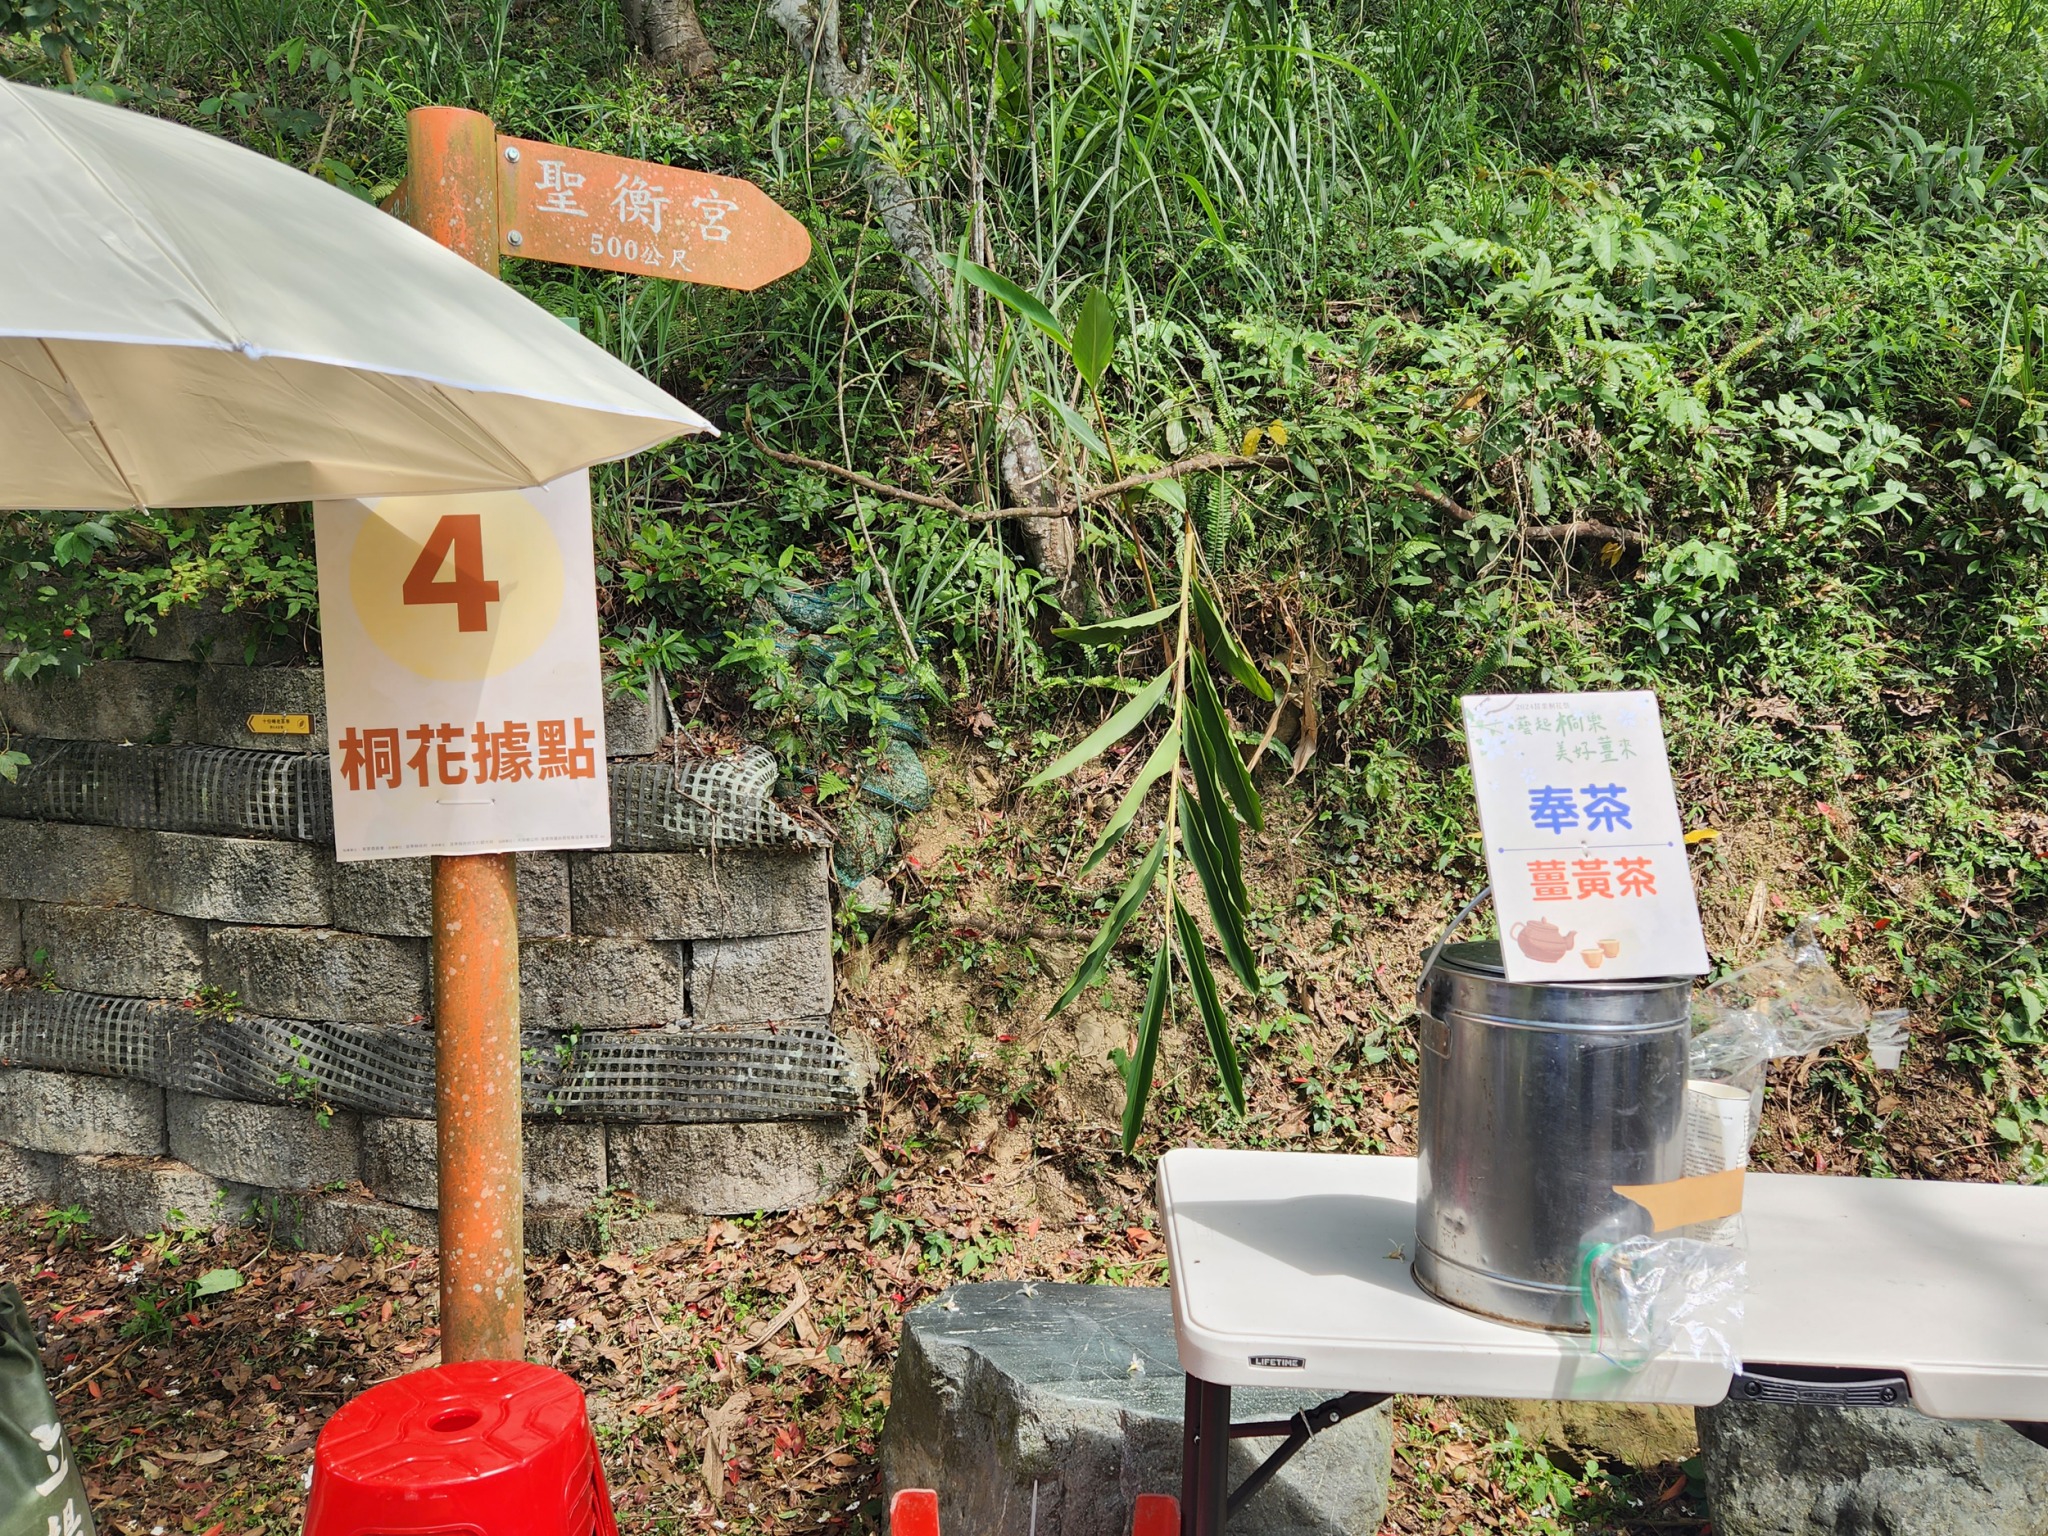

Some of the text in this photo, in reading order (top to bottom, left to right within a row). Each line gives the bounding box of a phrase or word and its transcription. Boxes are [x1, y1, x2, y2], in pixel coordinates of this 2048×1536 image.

[535, 159, 740, 242] 聖衡宮
[589, 233, 693, 273] 500公尺
[402, 514, 500, 633] 4
[338, 717, 596, 791] 桐花據點
[1555, 735, 1638, 763] 美好薑來
[1528, 783, 1633, 835] 奉茶
[1527, 857, 1658, 902] 薑黃茶
[1256, 1357, 1298, 1367] LIFETIME
